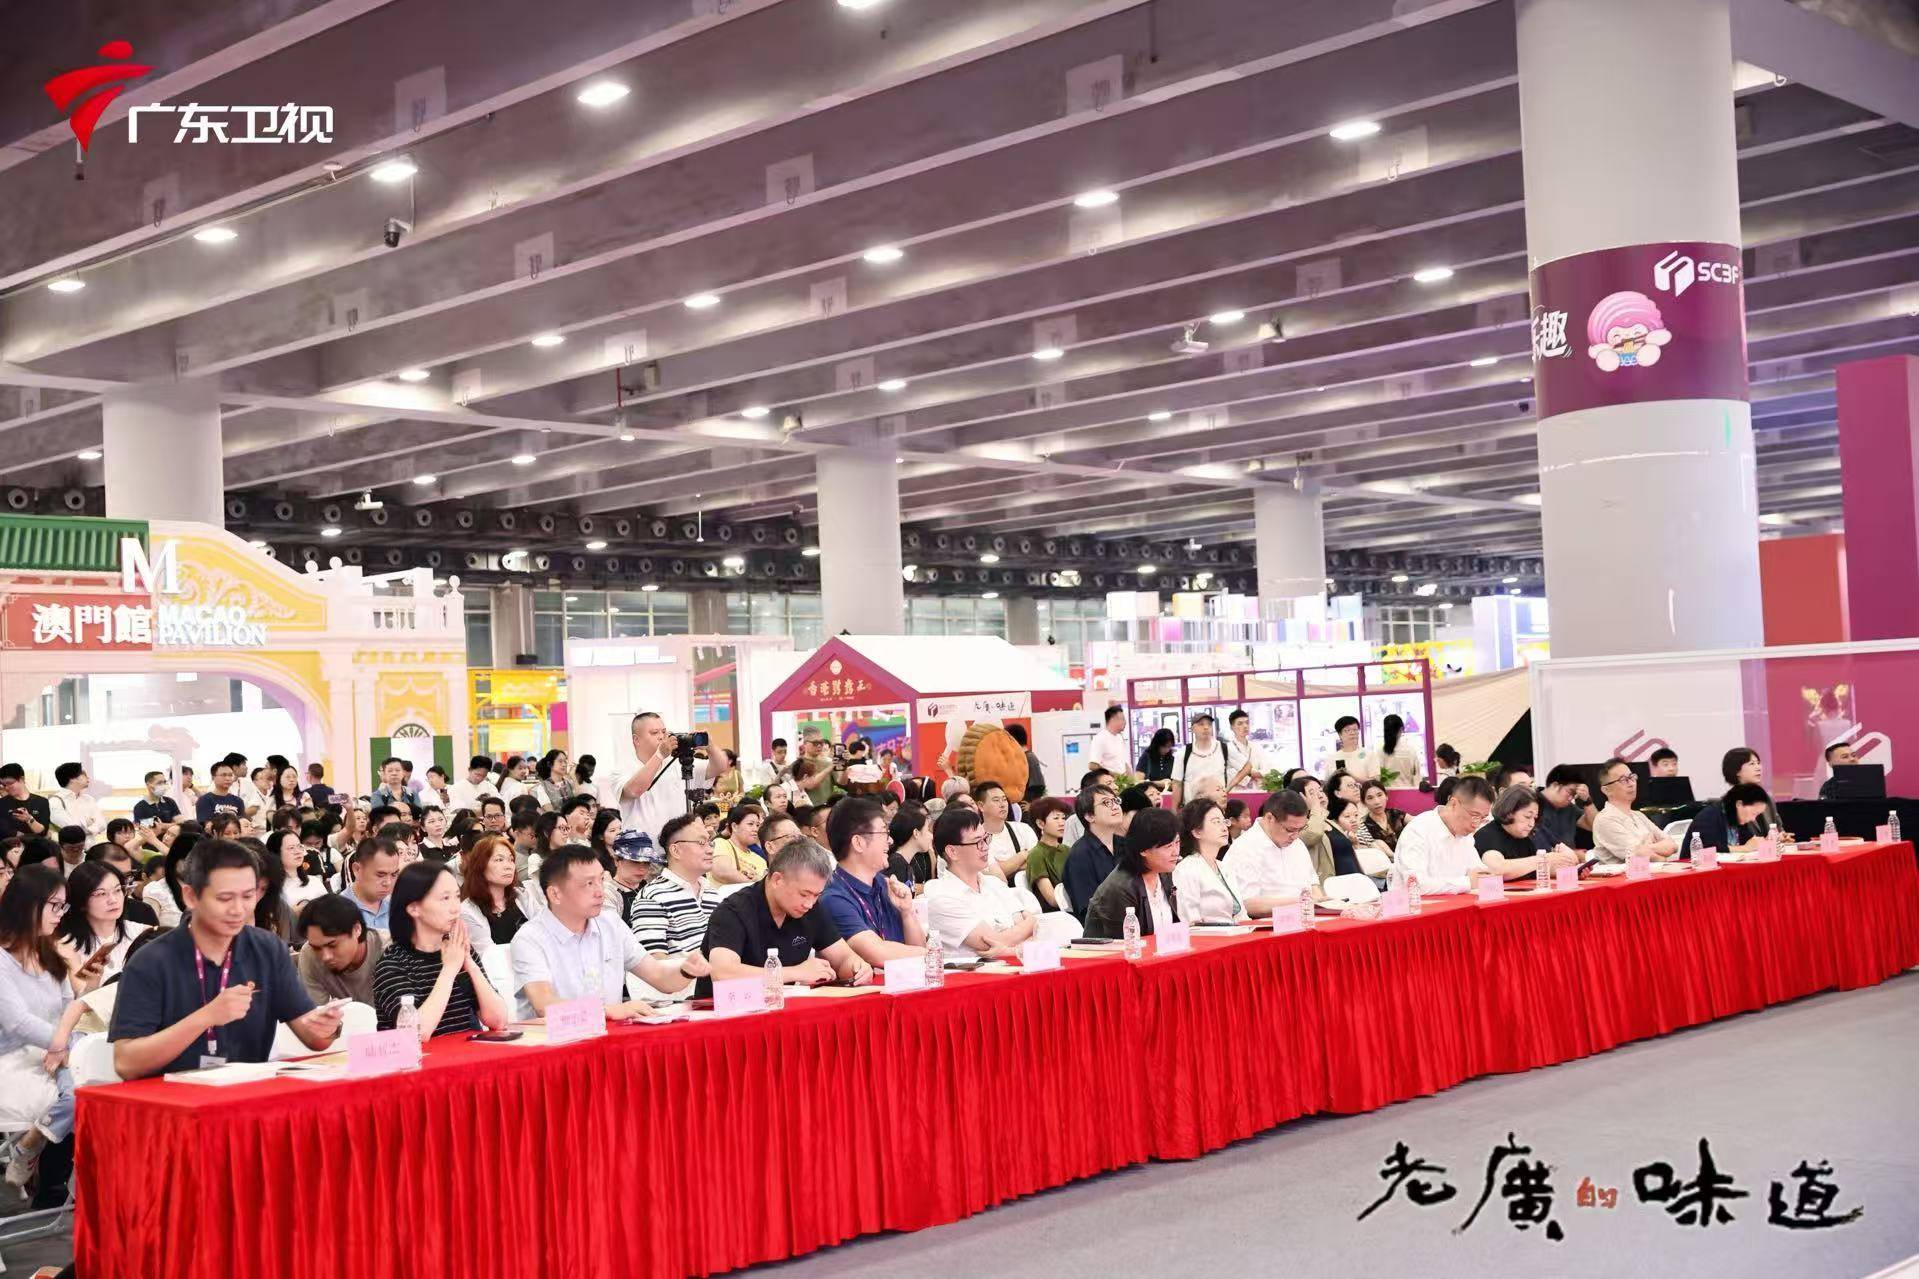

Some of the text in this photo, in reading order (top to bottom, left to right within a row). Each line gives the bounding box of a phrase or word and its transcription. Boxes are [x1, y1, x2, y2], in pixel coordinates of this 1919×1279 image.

[121, 537, 183, 595] M
[31, 603, 153, 645] 澳門館
[158, 604, 247, 626] MACAO
[158, 623, 268, 647] PAVILION
